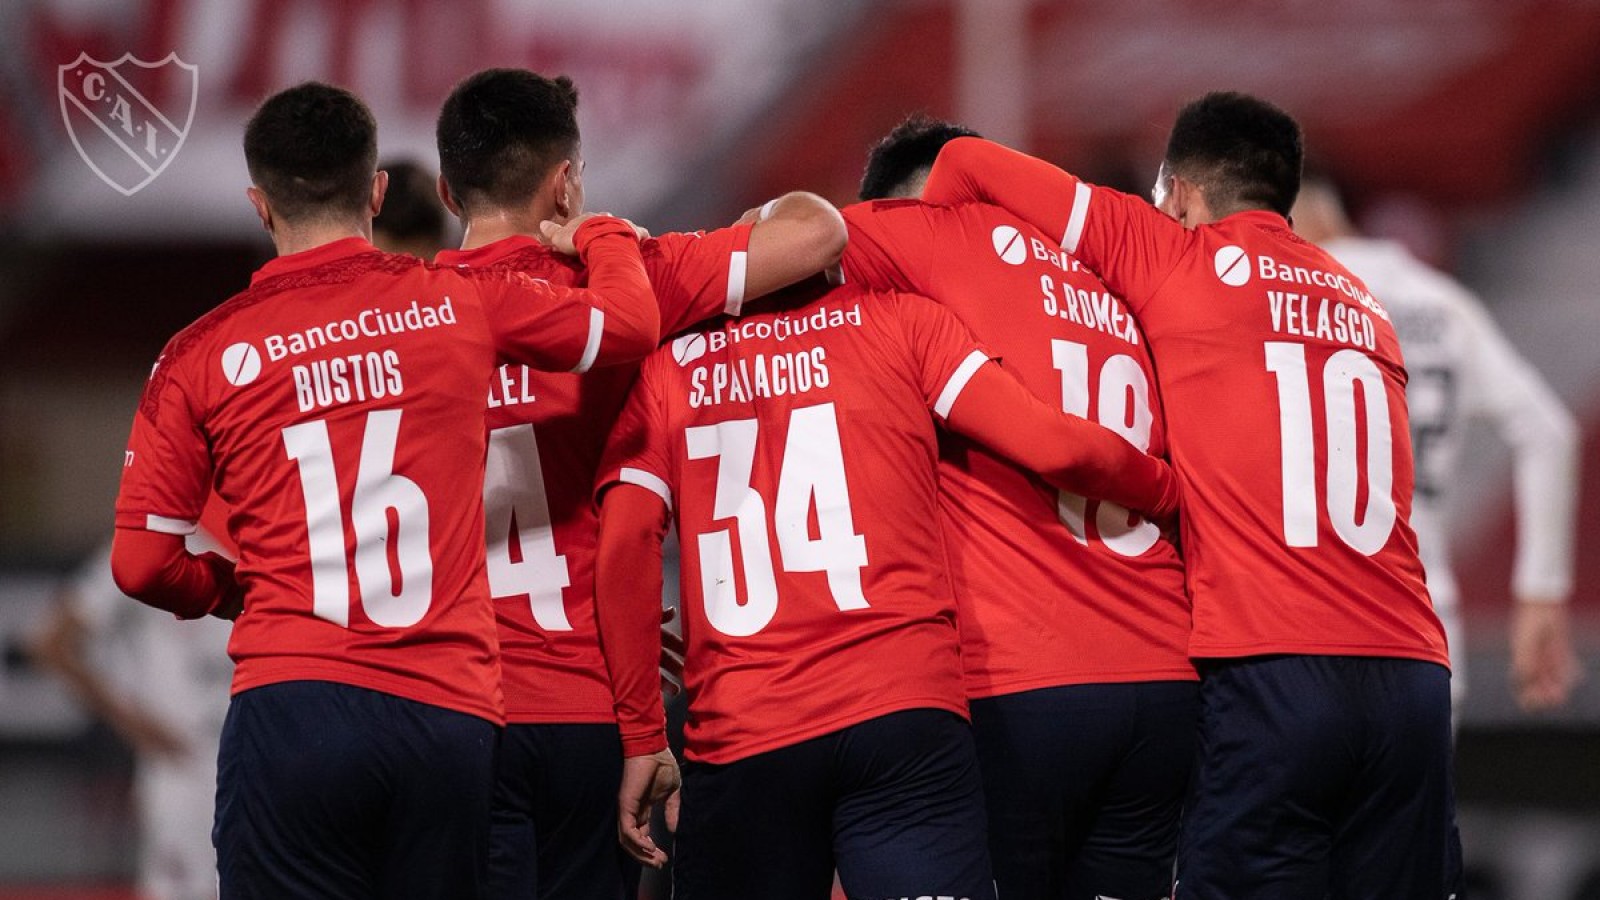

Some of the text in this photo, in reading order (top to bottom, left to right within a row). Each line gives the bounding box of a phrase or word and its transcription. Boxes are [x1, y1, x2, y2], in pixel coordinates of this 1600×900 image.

[264, 296, 456, 362] BancoCiudad
[292, 350, 403, 412] BUSTOS
[1267, 291, 1376, 351] VELASCO
[281, 408, 432, 628] 16
[1264, 341, 1396, 556] 10
[685, 401, 871, 637] 34
